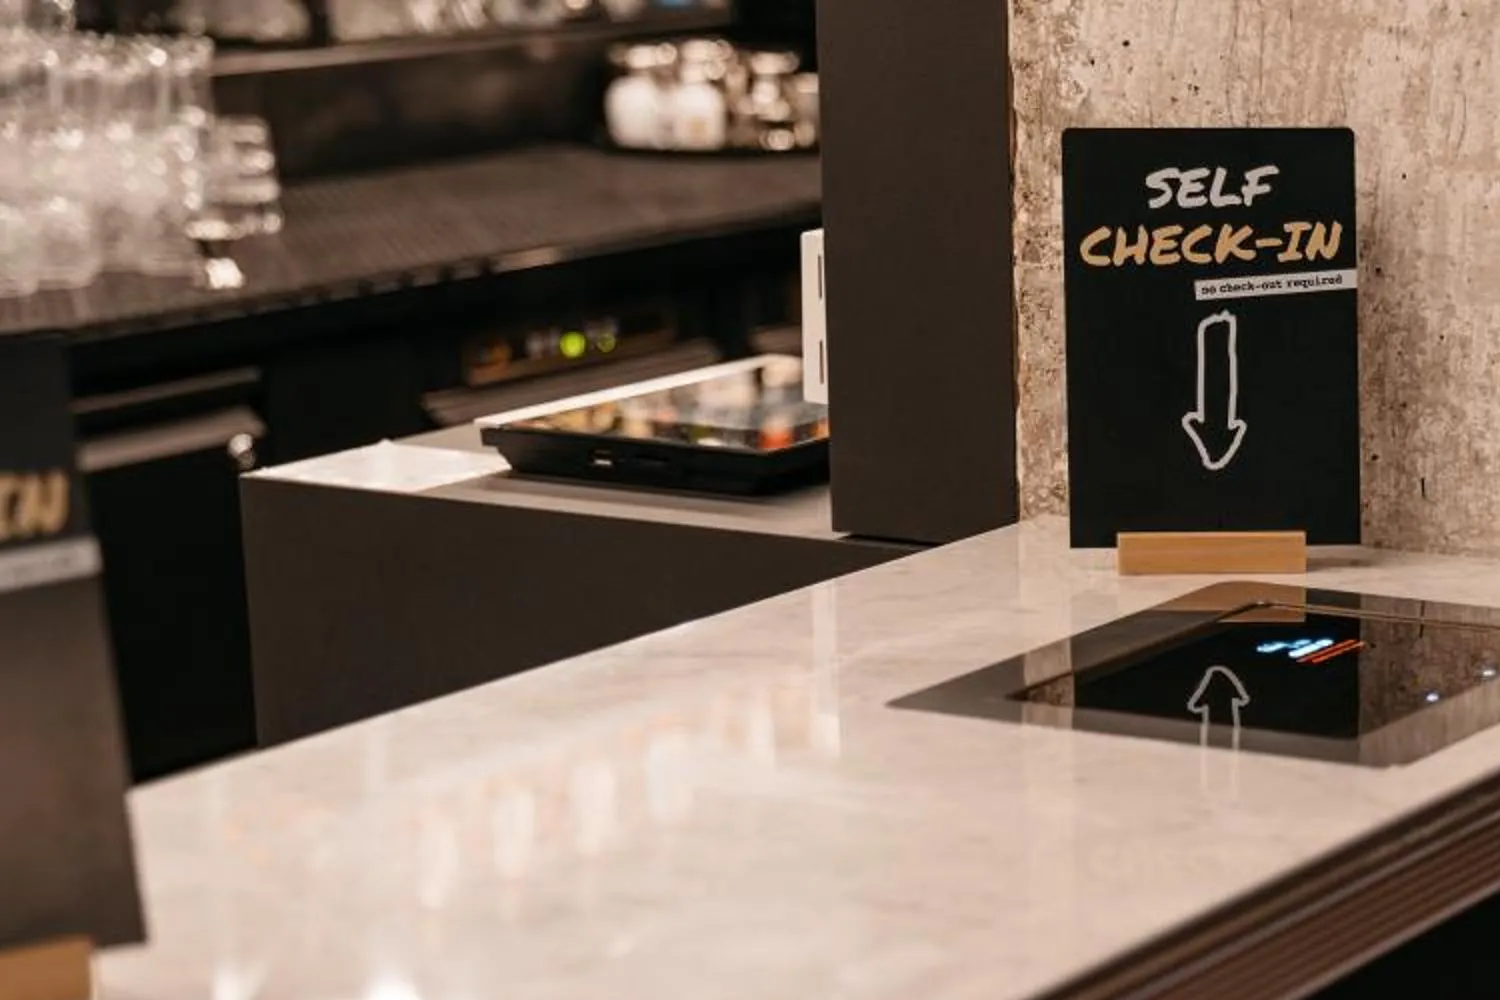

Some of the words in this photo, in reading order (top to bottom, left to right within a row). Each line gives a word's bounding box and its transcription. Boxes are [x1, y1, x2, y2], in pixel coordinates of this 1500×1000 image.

[1145, 164, 1280, 209] SELF
[1079, 221, 1343, 267] CHECK-IN
[1219, 281, 1283, 294] check-out
[1286, 273, 1343, 289] required
